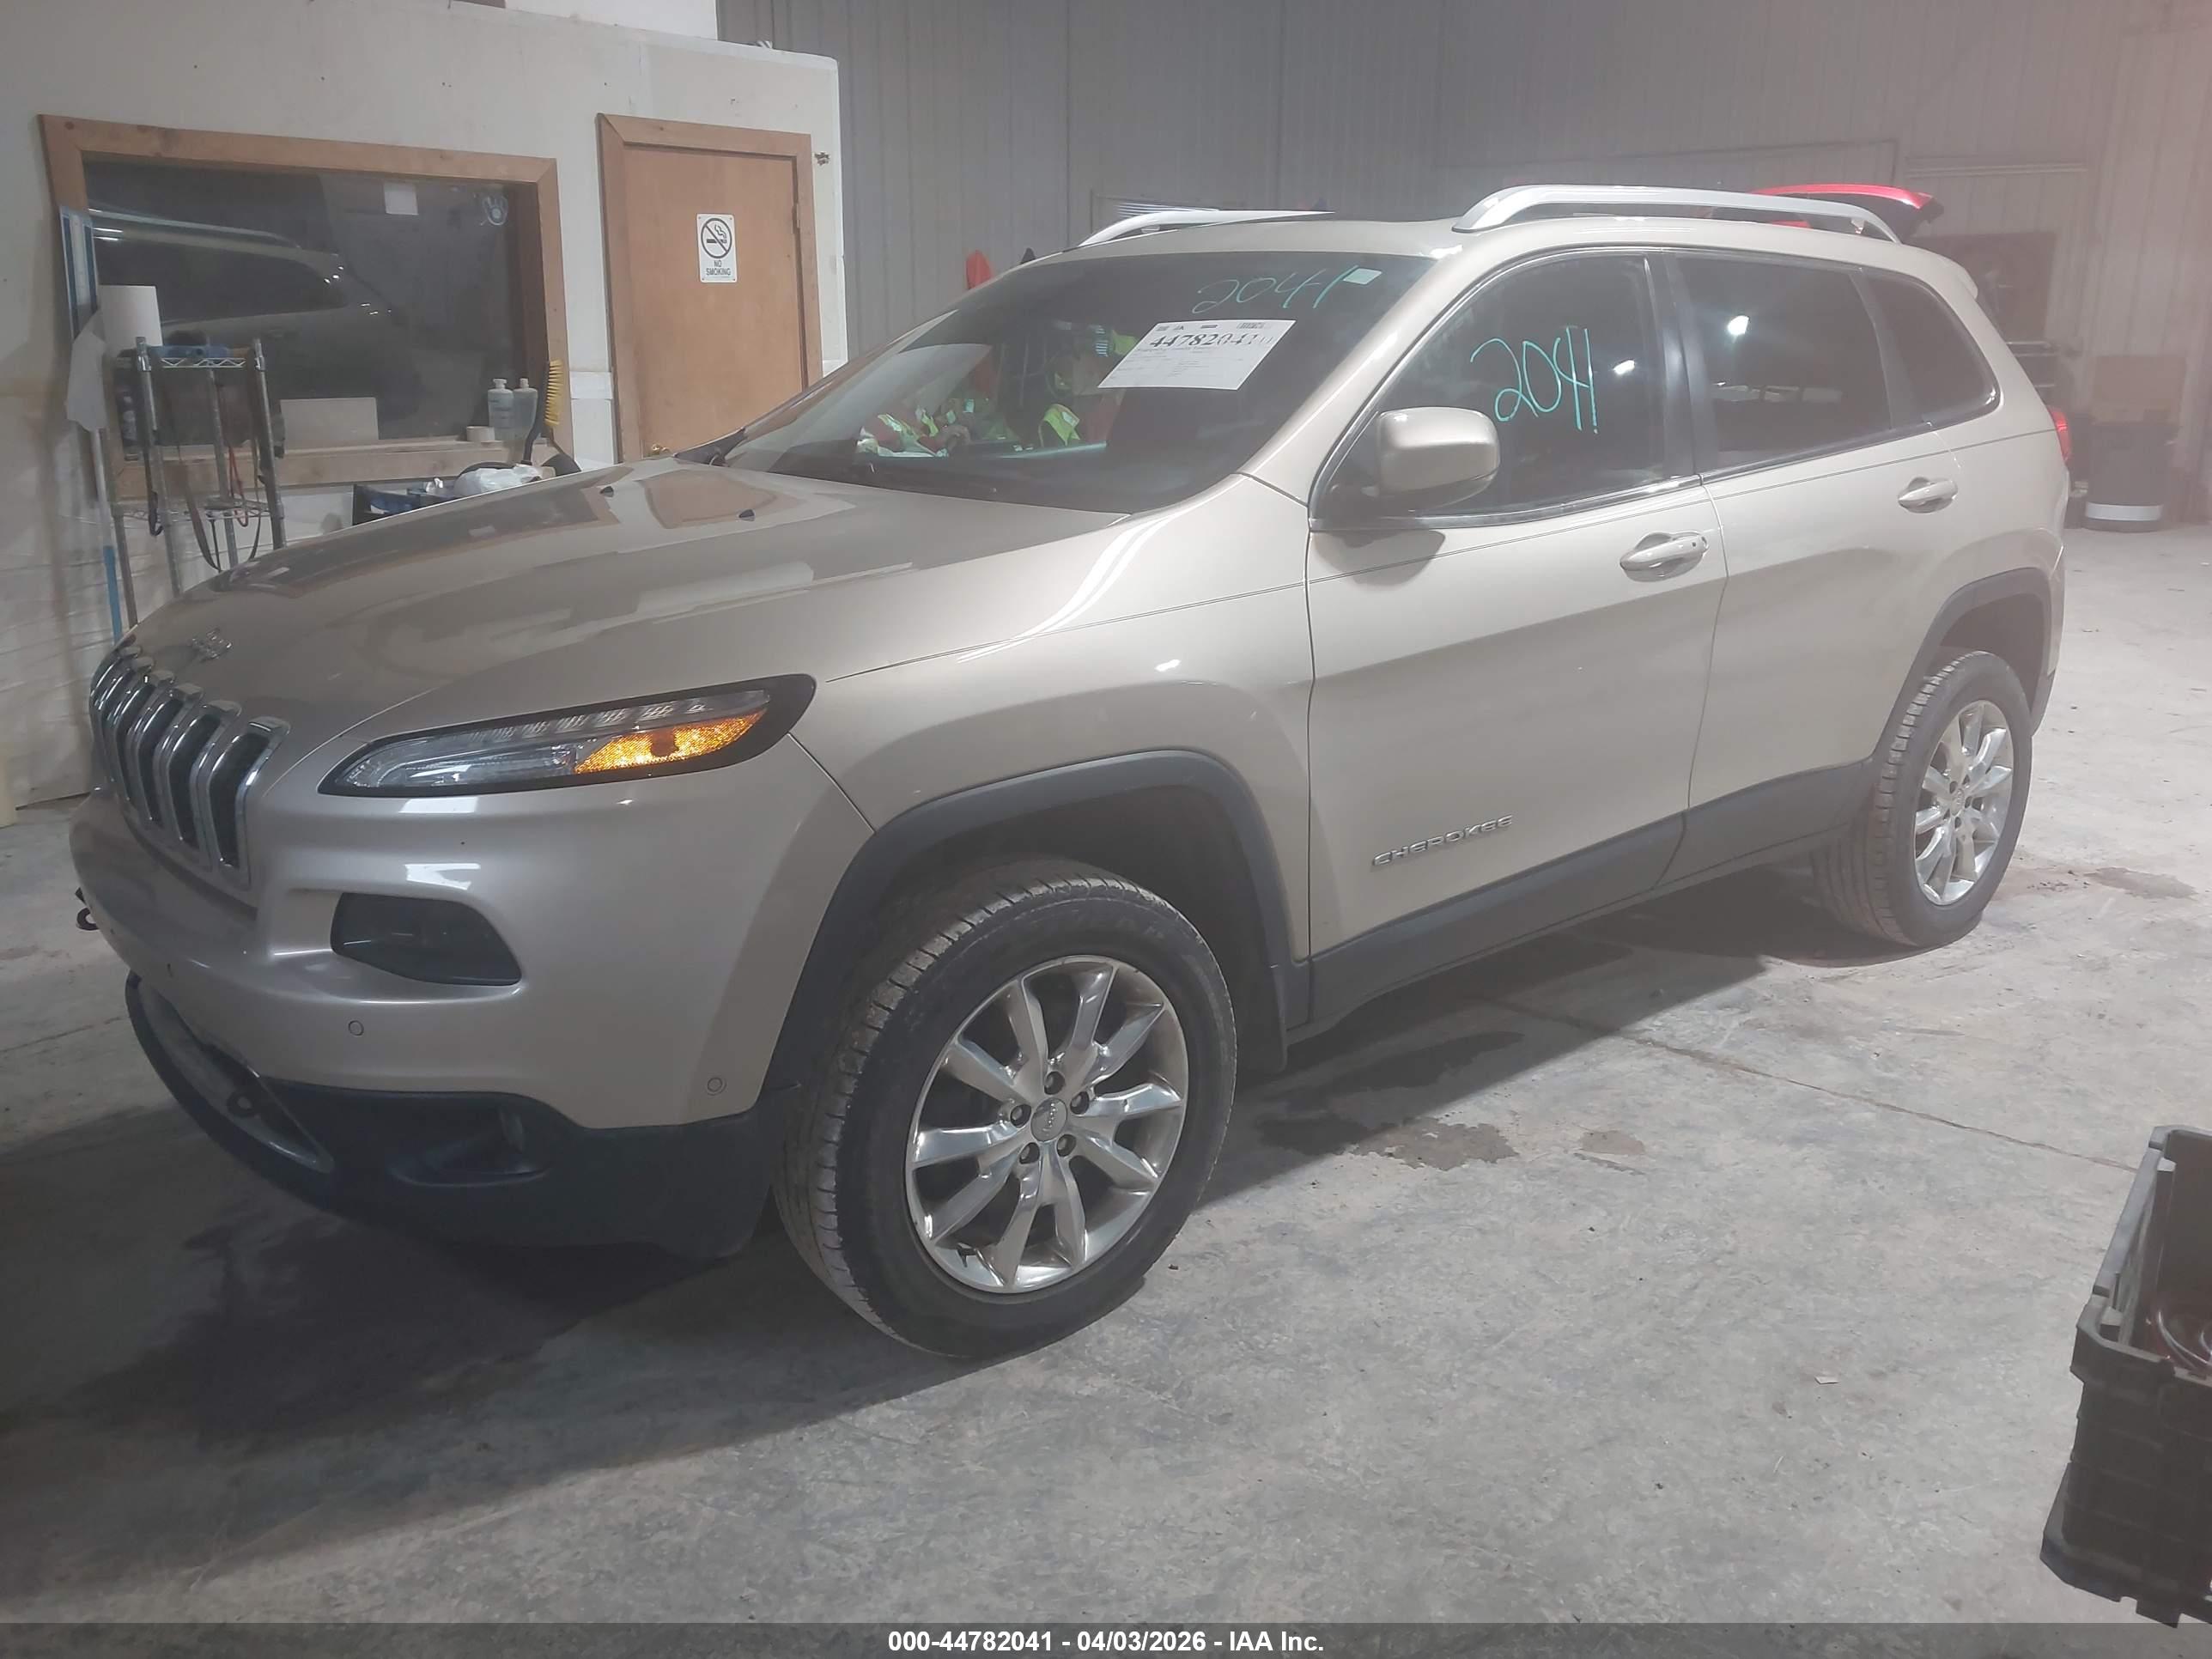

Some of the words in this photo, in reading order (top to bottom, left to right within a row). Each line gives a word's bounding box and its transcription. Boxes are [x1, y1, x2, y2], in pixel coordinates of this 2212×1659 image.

[714, 259, 722, 268] NO
[1191, 265, 1358, 314] 2041
[1469, 326, 1598, 434] 2041
[1372, 815, 1512, 866] CHEROKEE
